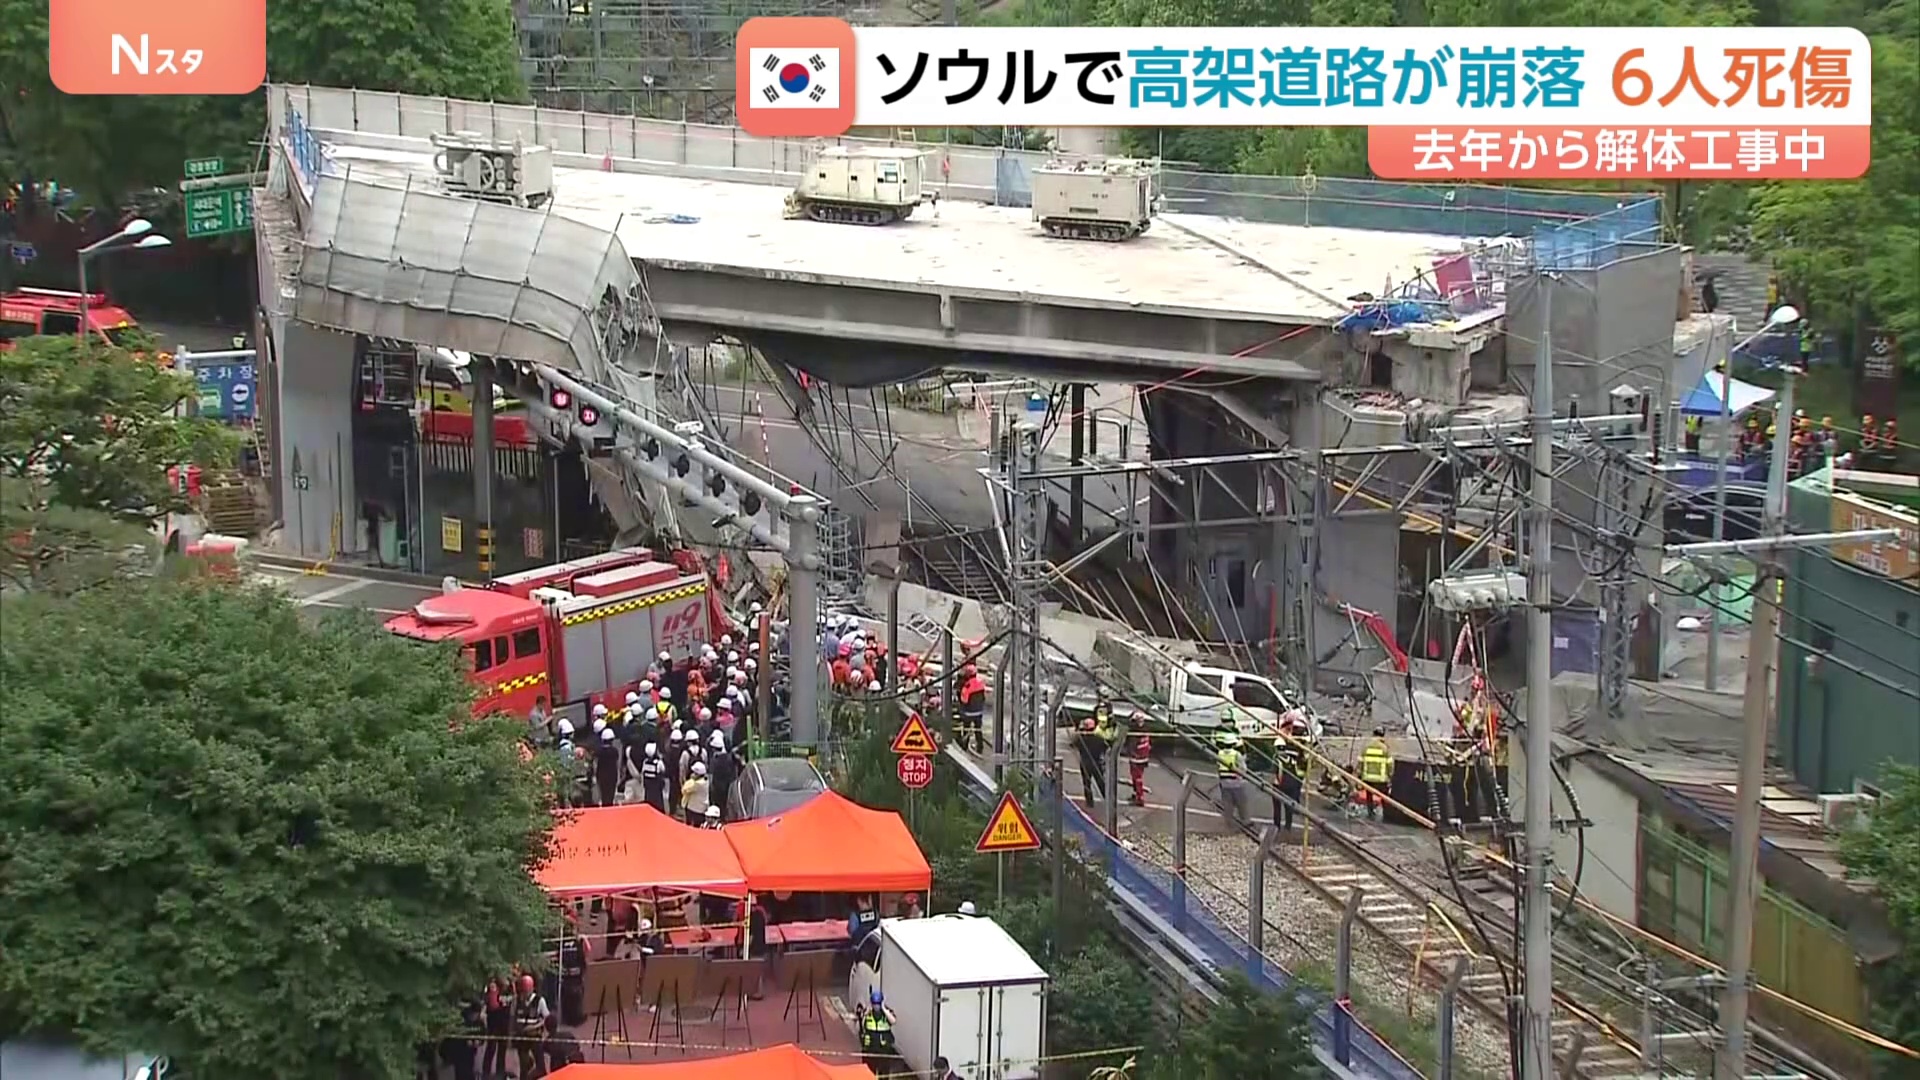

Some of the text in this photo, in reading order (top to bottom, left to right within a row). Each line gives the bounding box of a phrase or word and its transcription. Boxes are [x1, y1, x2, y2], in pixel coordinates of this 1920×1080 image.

[196, 364, 253, 382] 주차장
[664, 601, 701, 633] 119
[661, 627, 705, 653] 구조대
[903, 758, 927, 771] 정지
[903, 772, 927, 783] STOP
[998, 821, 1019, 834] 위험
[993, 833, 1022, 842] DANGER
